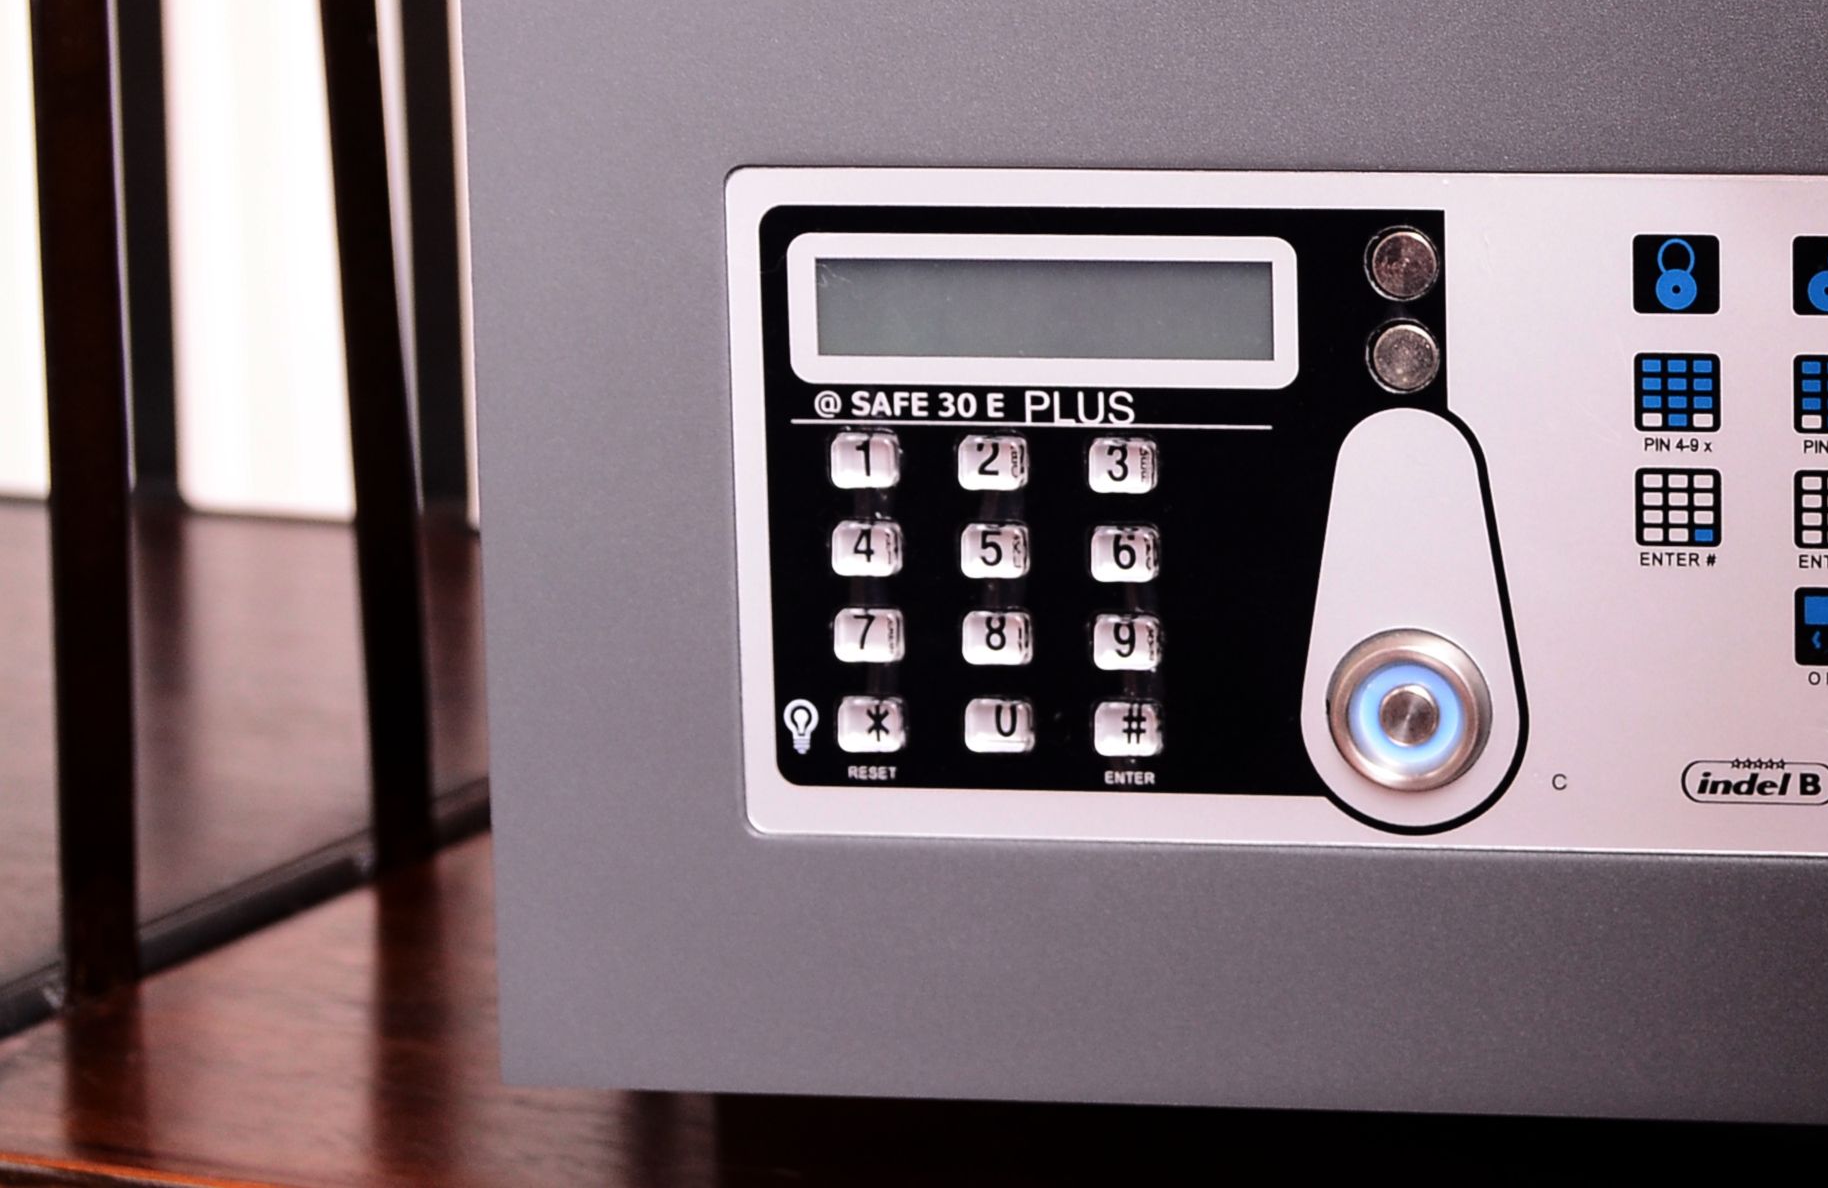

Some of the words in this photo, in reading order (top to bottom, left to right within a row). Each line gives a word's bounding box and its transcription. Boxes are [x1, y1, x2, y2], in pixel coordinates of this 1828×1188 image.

[814, 390, 842, 419] @
[851, 390, 929, 417] SAFE
[937, 392, 978, 418] 30
[986, 393, 1005, 418] E
[1024, 390, 1136, 424] PLUS
[855, 439, 872, 477] 1
[976, 442, 1000, 476] 2
[1644, 437, 1670, 452] PIN
[1675, 438, 1699, 453] 4-9
[1106, 444, 1129, 482] 3
[853, 528, 875, 563] 4
[980, 530, 1003, 567] 5
[1112, 533, 1137, 570] 6
[1640, 551, 1698, 567] ENTER
[1705, 553, 1717, 567] #
[853, 614, 876, 650] 7
[984, 615, 1007, 651] 8
[1113, 621, 1136, 658] 9
[847, 765, 897, 780] RESET
[1104, 770, 1155, 785] ENTER
[1551, 773, 1567, 791] C
[1697, 771, 1792, 797] indel
[1799, 772, 1822, 796] B
